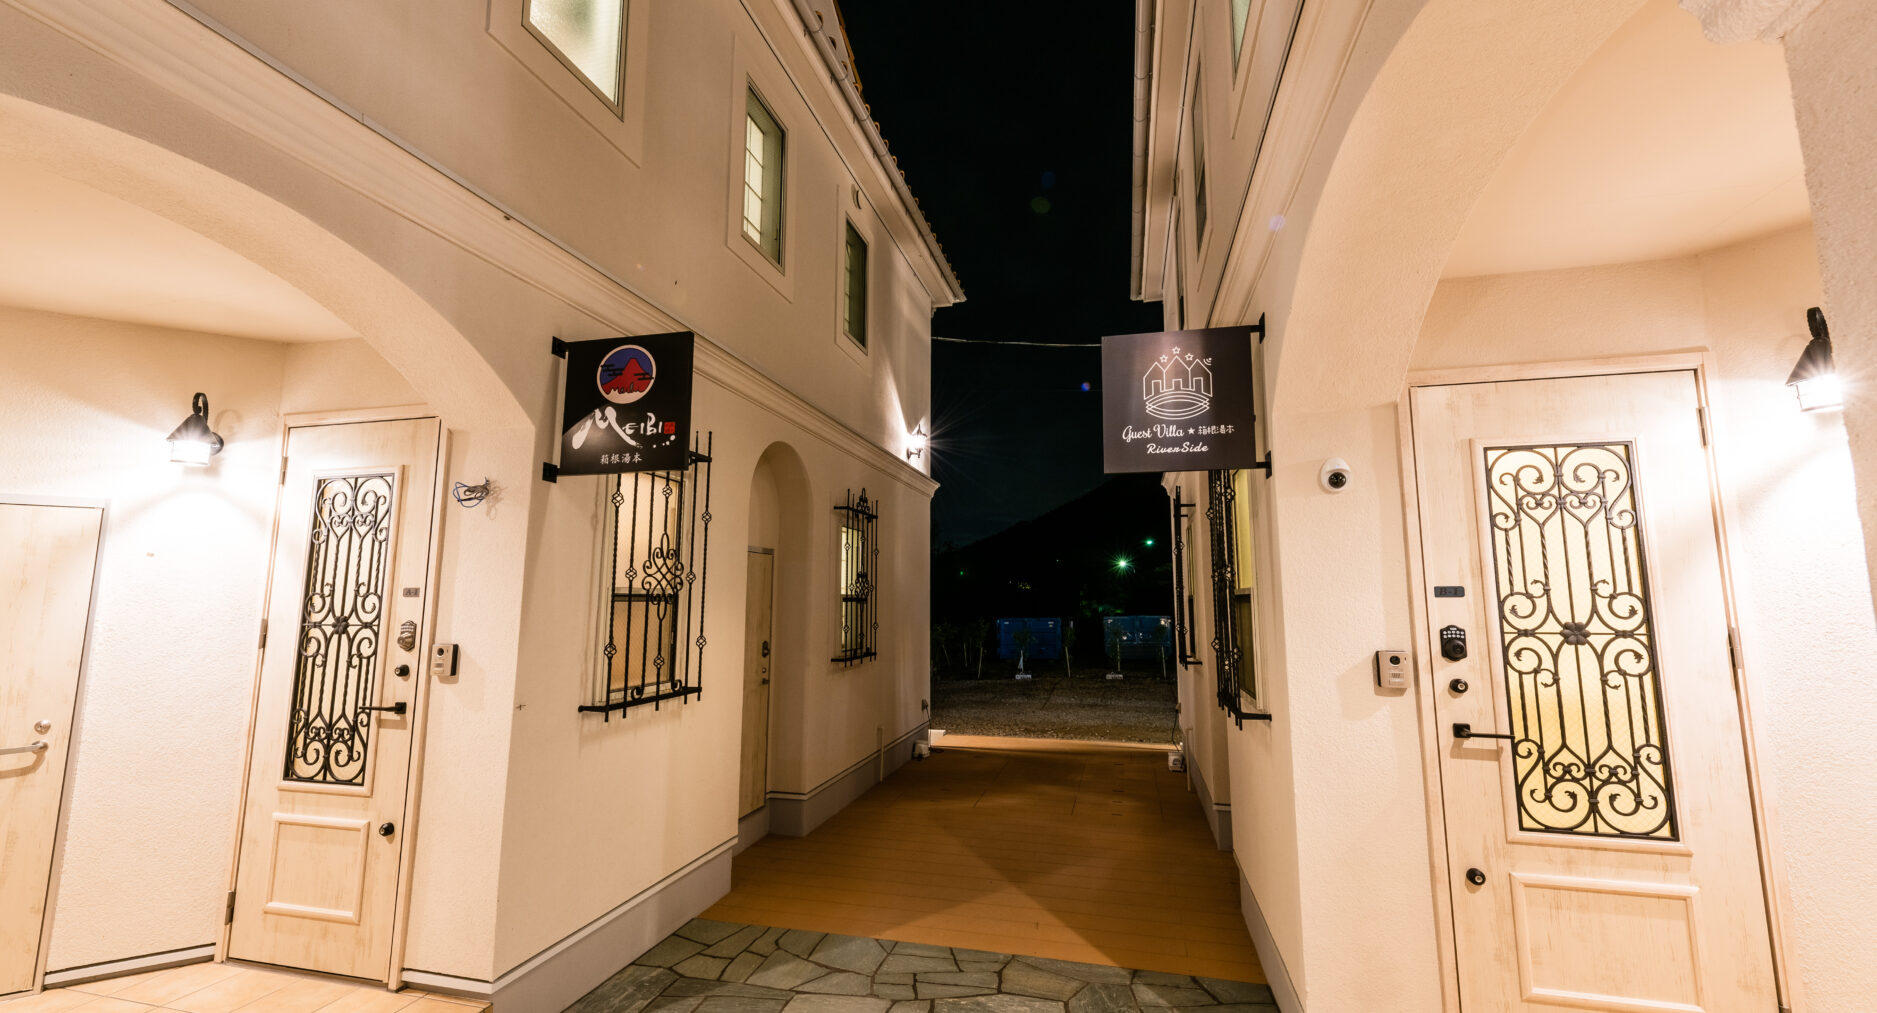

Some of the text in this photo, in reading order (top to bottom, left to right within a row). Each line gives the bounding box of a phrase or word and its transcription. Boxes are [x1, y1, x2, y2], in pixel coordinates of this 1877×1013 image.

[1122, 424, 1235, 442] Guest Villa 箱根湯本
[600, 452, 643, 465] 箱根湯本
